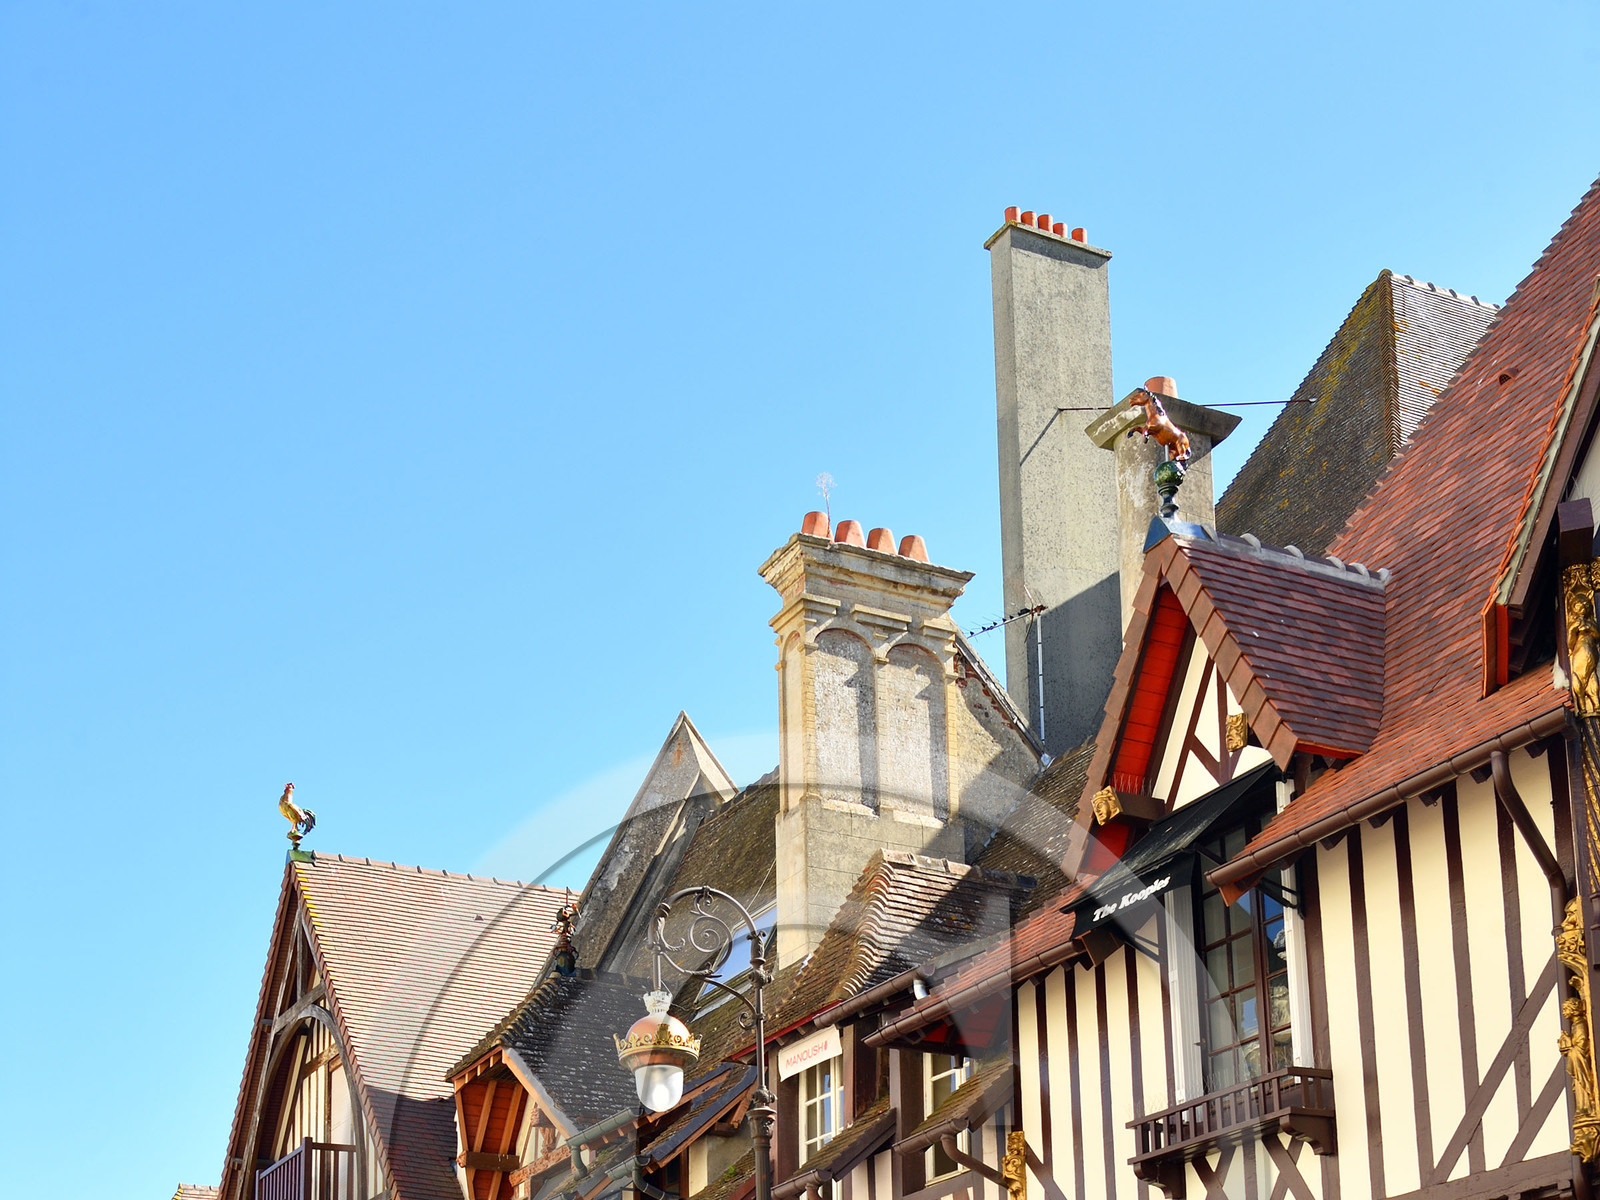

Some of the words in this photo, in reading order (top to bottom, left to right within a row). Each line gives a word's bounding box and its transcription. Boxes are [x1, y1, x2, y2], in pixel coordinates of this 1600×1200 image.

[1092, 903, 1118, 922] The
[1118, 876, 1171, 910] Kooples
[785, 1041, 824, 1069] MANOUSH
